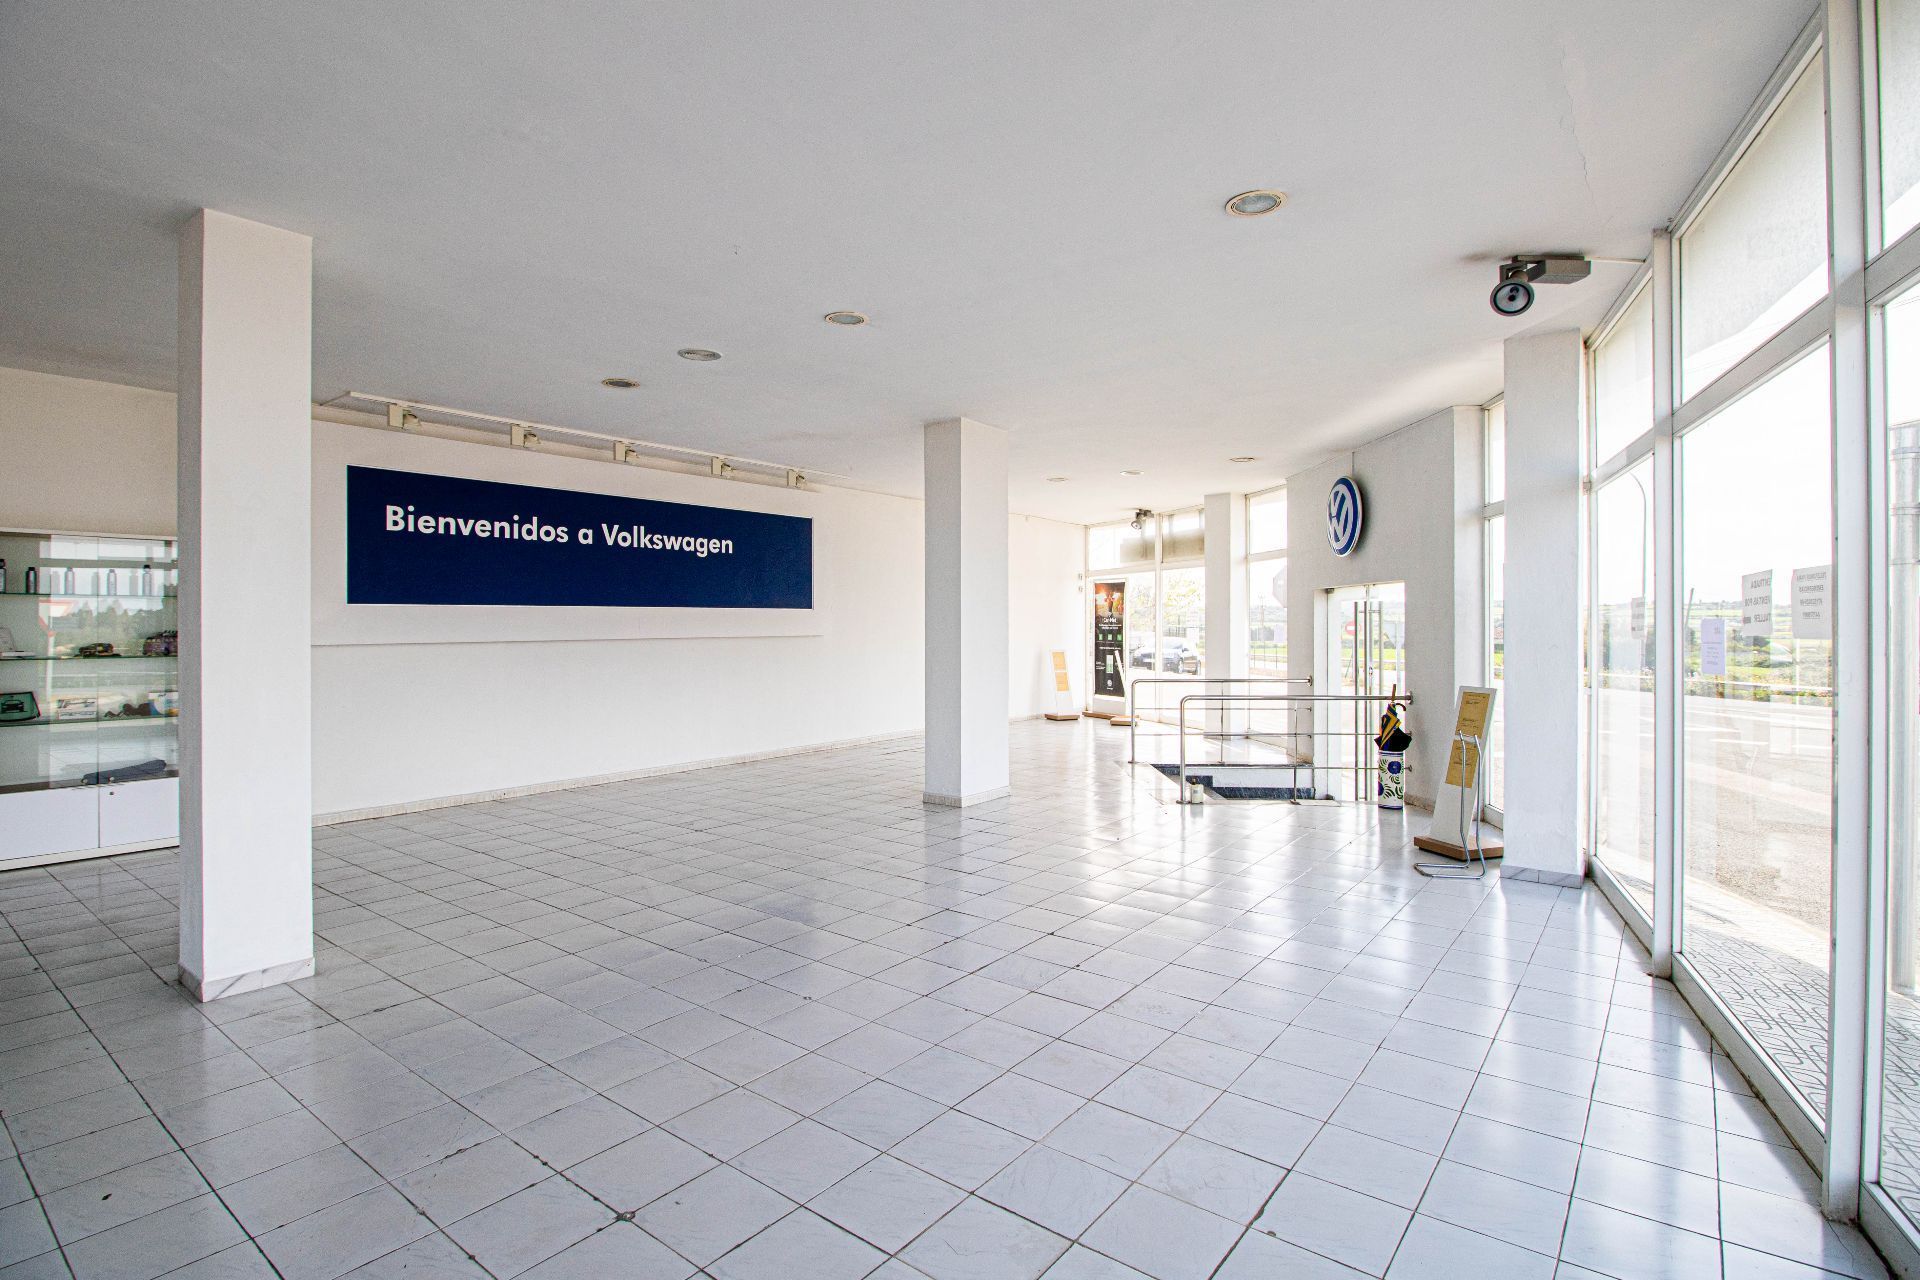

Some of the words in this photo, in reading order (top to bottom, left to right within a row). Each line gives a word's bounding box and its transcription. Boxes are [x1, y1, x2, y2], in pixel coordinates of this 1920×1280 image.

[385, 504, 569, 543] Bienvenidos
[577, 526, 593, 545] a
[601, 523, 733, 558] Volkswagen
